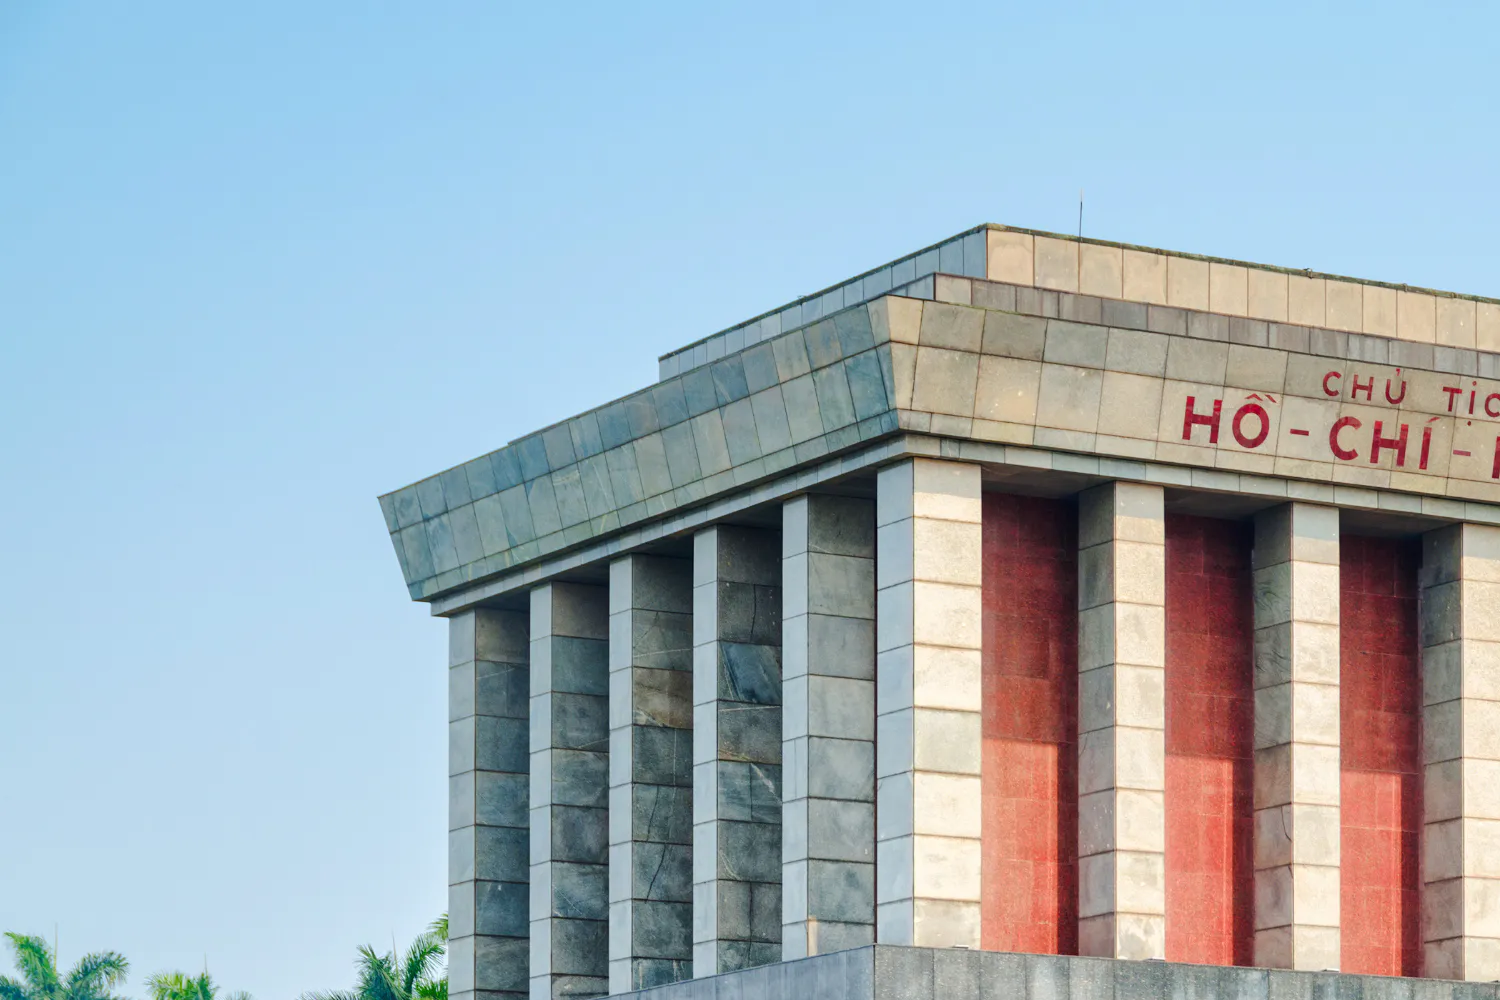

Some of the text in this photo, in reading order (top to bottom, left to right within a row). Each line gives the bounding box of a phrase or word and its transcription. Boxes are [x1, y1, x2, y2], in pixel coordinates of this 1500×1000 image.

[1322, 368, 1407, 405] CHỦ
[1182, 393, 1278, 449] HỒ
[1329, 415, 1441, 470] CHÍ
